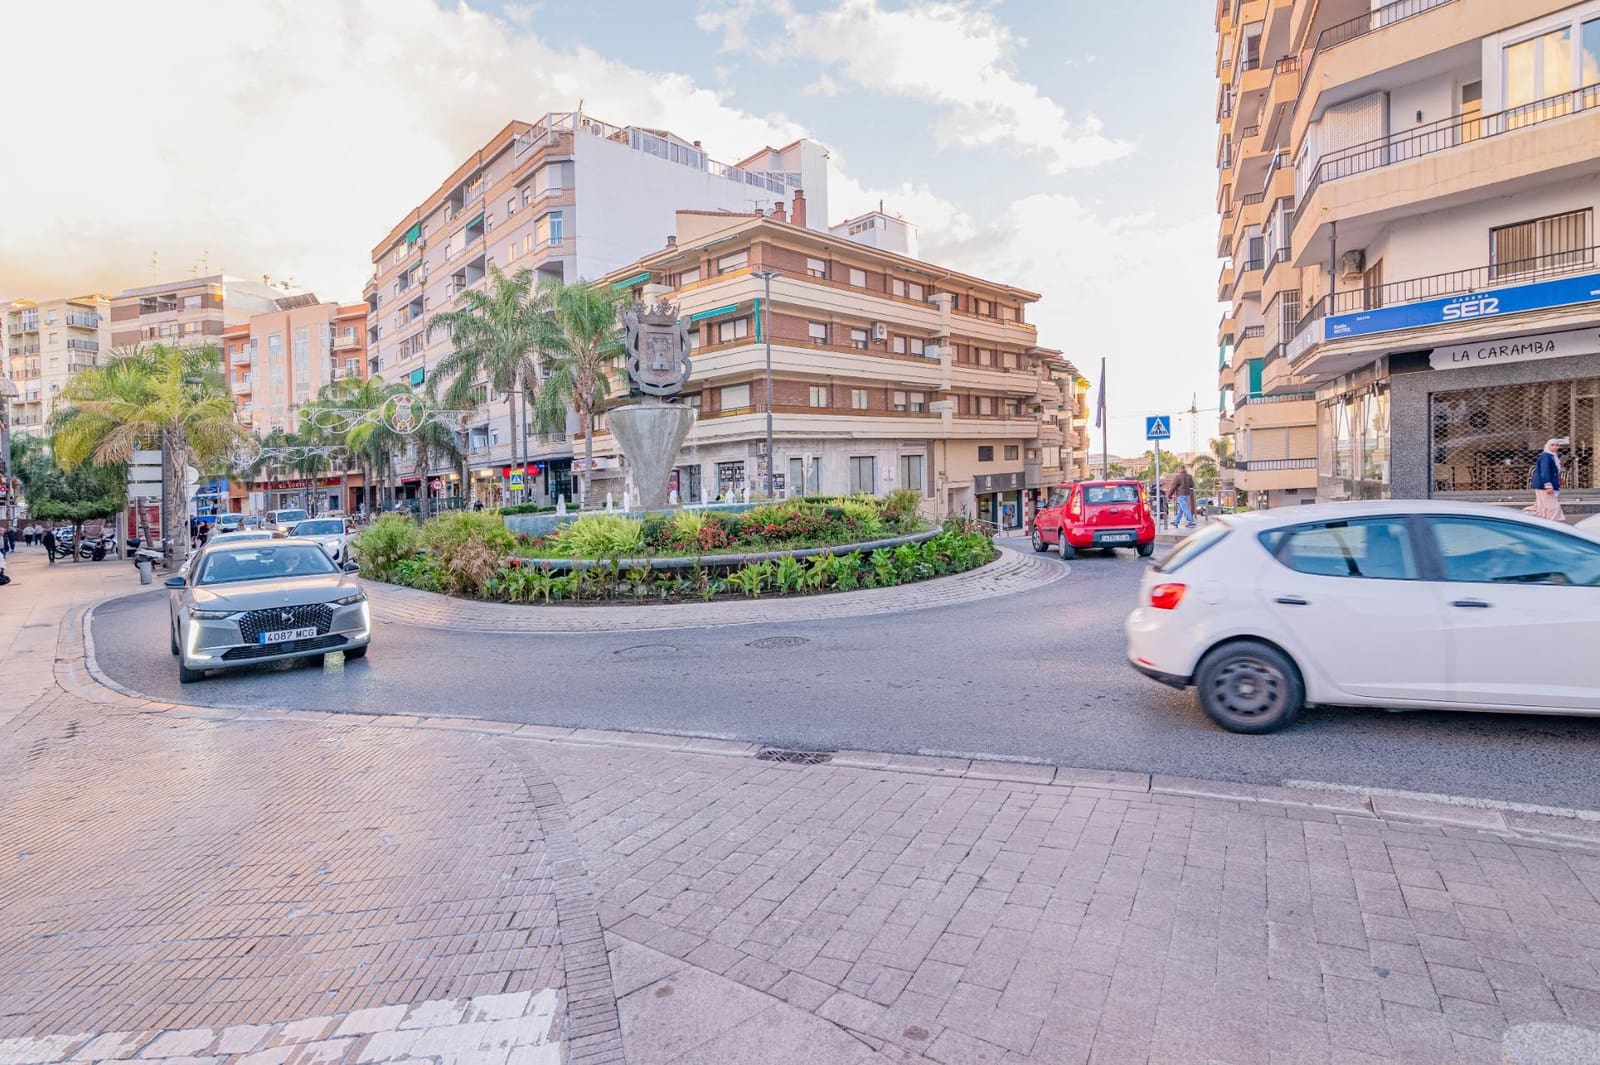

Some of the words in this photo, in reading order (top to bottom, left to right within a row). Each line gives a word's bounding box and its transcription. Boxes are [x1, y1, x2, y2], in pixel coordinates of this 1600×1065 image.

[1442, 297, 1500, 321] SER
[1452, 350, 1470, 362] LA
[1477, 340, 1555, 360] CARAMBA
[267, 630, 293, 642] 4087
[295, 628, 314, 639] MCG
